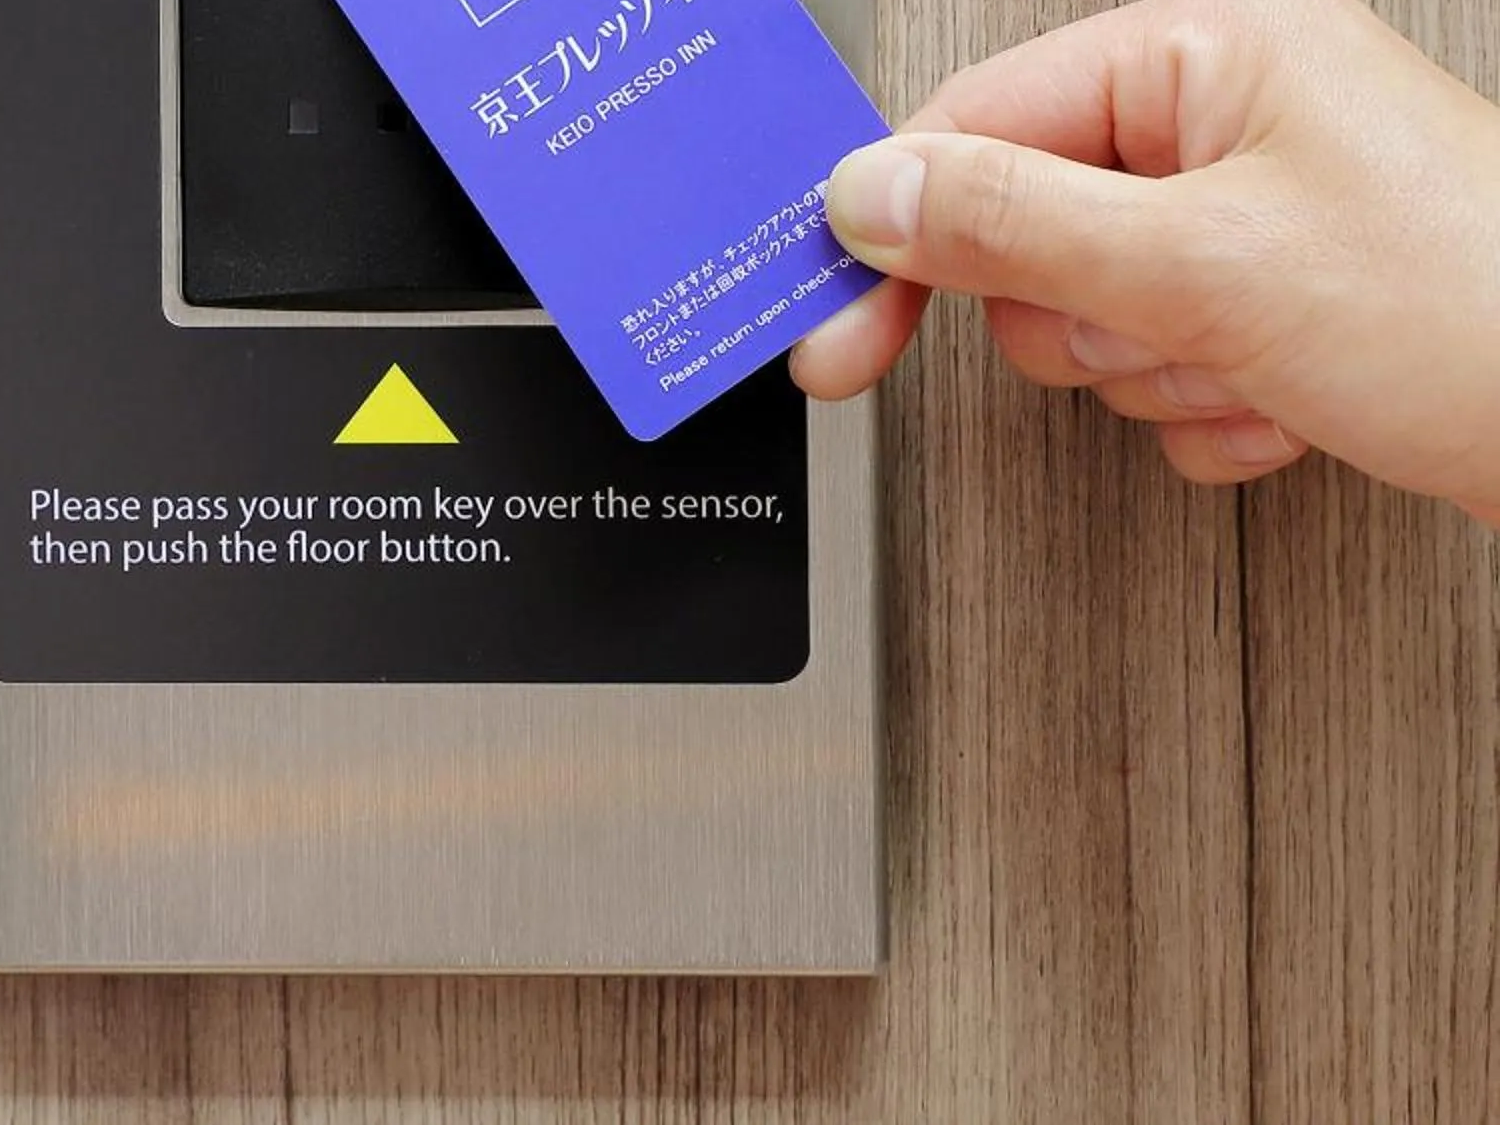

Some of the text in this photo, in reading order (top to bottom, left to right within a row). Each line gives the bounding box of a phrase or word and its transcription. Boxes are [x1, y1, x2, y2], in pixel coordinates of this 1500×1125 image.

[545, 28, 718, 156] KEIO PRESSO INN
[659, 355, 710, 392] Please
[709, 323, 753, 359] return
[755, 296, 791, 329] upon
[31, 486, 784, 532] Please pass your room key over the sensor,
[29, 530, 512, 573] then push the floor button.
